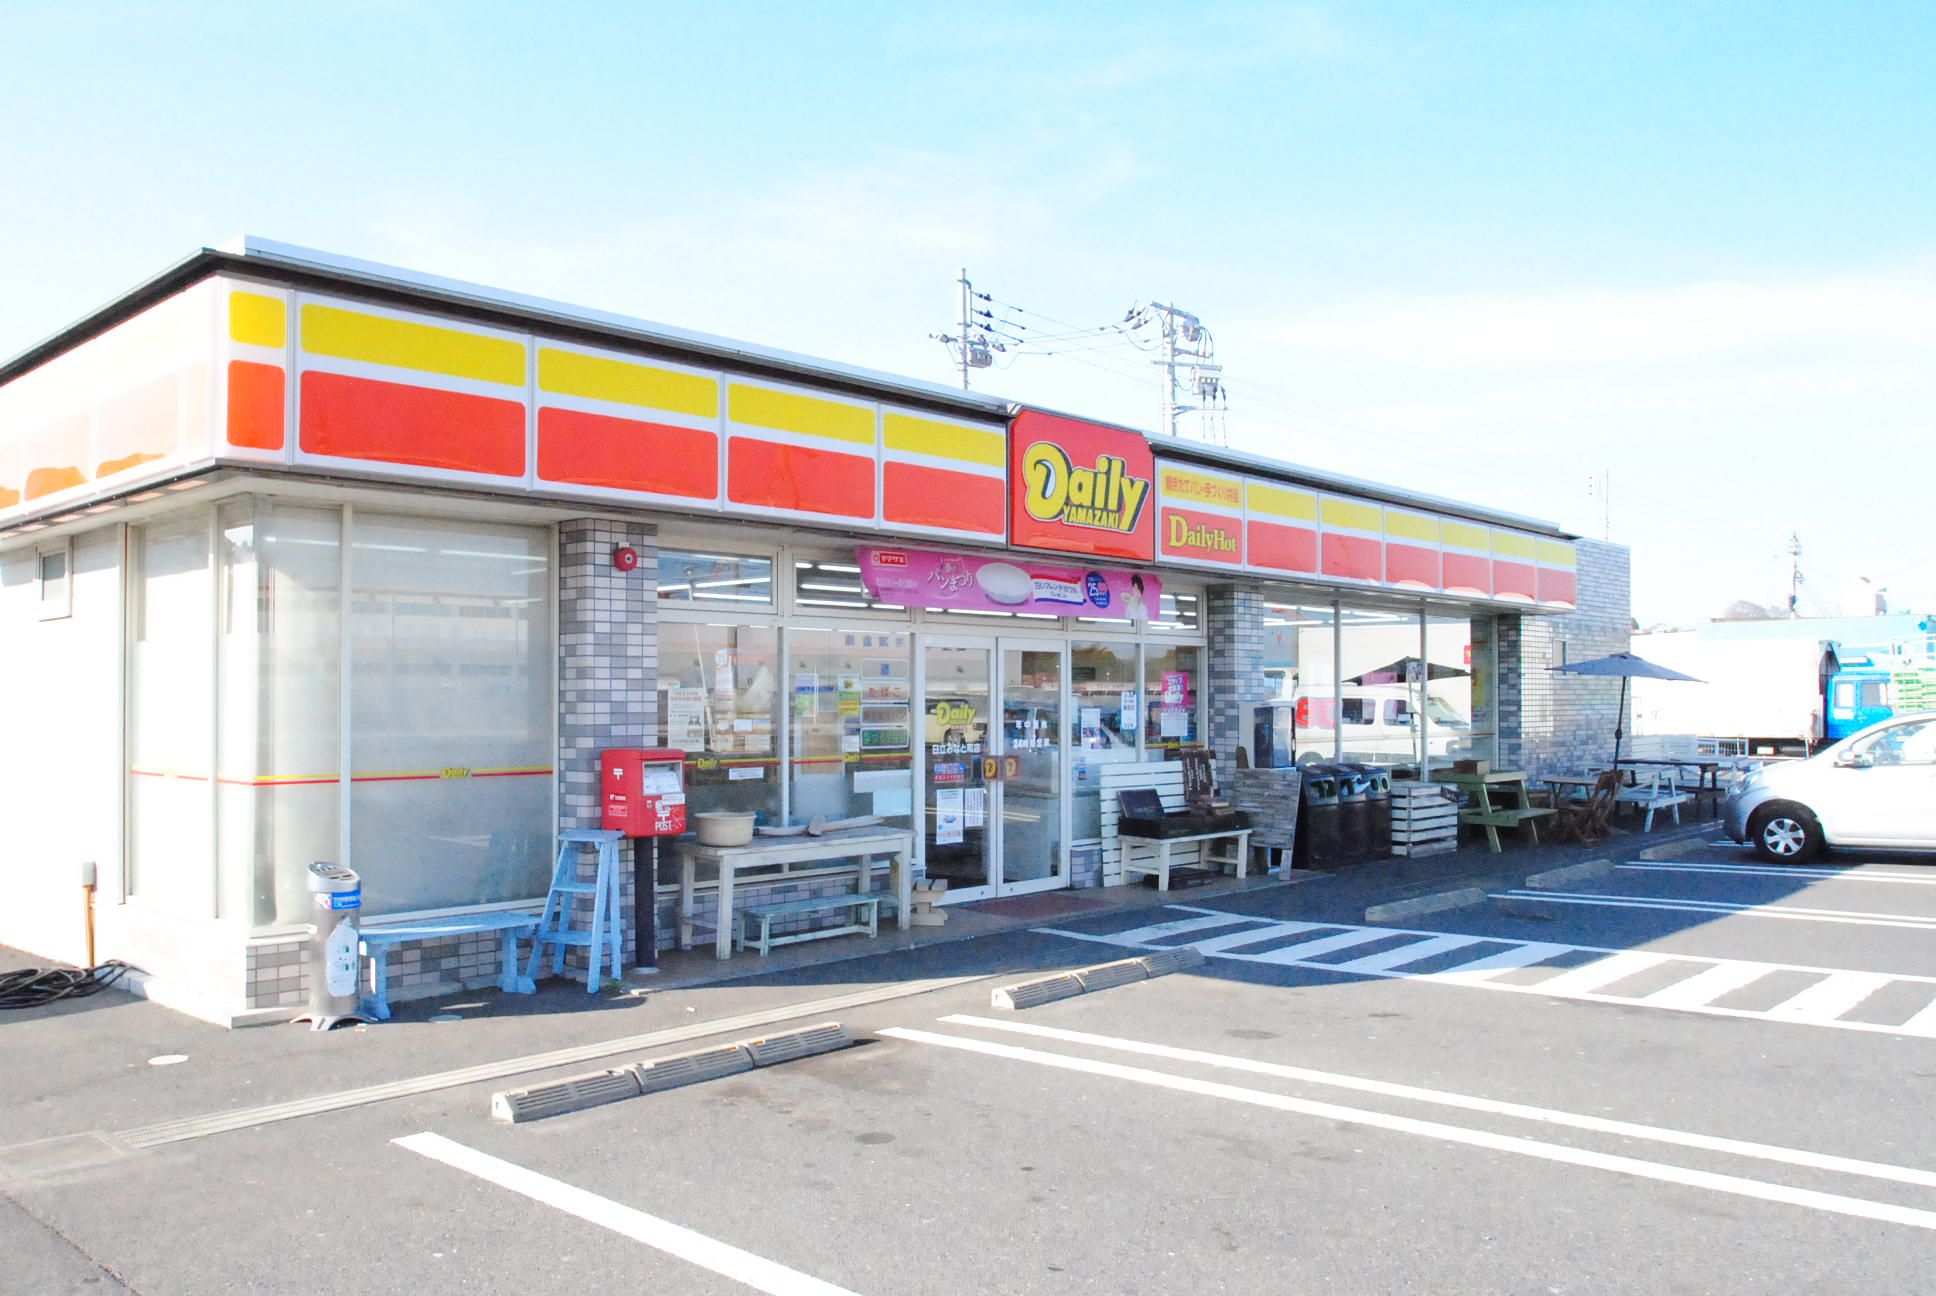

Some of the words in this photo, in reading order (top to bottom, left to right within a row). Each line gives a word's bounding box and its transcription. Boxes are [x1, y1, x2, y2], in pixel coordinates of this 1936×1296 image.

[1024, 442, 1149, 532] Daily
[1063, 504, 1120, 529] YAMAZAKI
[868, 686, 903, 699] たばこ
[936, 701, 977, 726] Daily
[442, 767, 470, 779] Daily
[655, 820, 673, 832] POST
